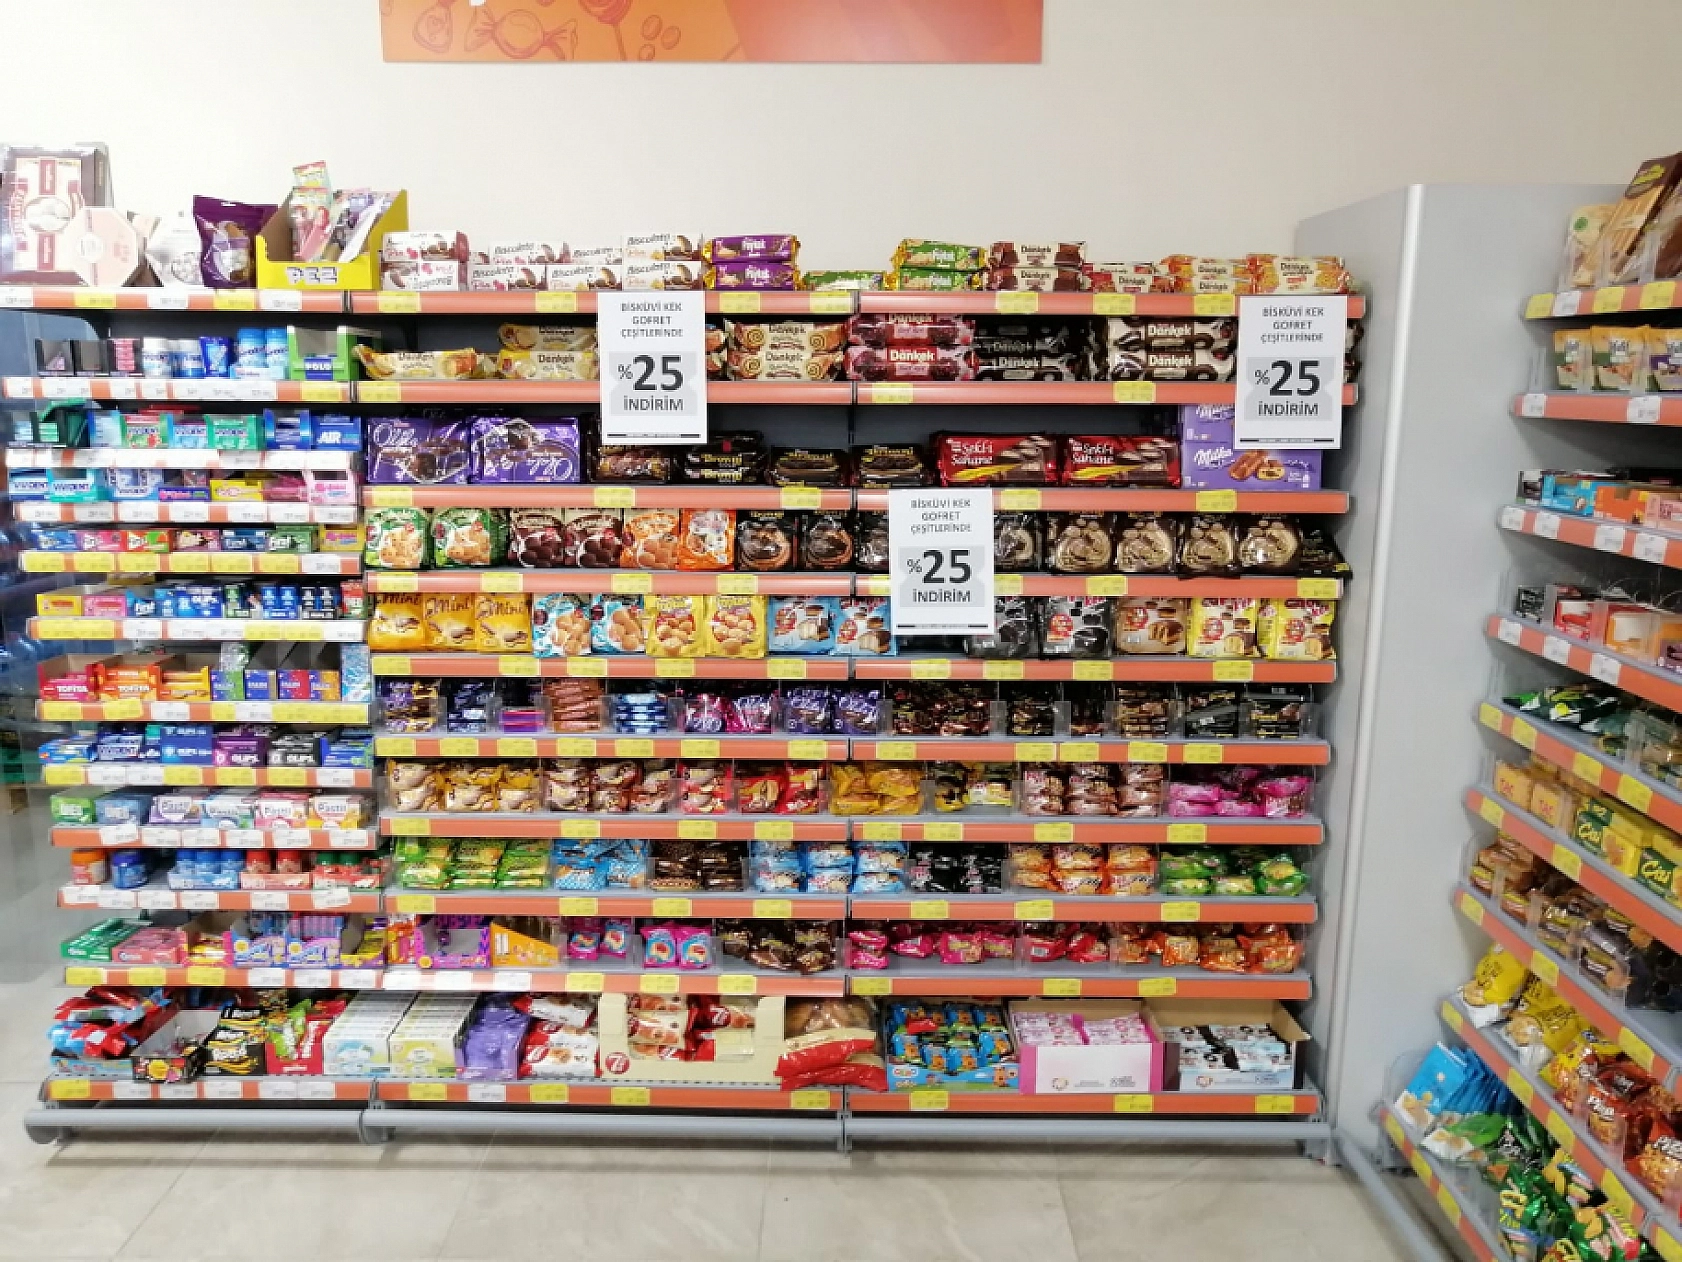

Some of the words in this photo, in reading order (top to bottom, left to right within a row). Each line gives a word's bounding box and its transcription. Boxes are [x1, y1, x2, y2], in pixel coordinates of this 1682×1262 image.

[621, 301, 661, 311] BİSKÜVİ
[663, 302, 684, 311] KEK
[1261, 305, 1304, 317] BİSKÜVİ
[1305, 306, 1325, 317] KEK
[632, 315, 672, 325] GOFRET
[1272, 320, 1314, 330] GOFRET
[620, 328, 684, 339] ÇEŞİTLERİNDE
[1260, 332, 1324, 344] ÇEŞİTLERİNDE
[623, 395, 684, 411] İNDİRİM
[1257, 400, 1319, 416] İNDİRİM
[910, 497, 950, 509] BİSKÜVİ
[952, 498, 972, 508] KEK
[921, 511, 961, 521] GOFRET
[910, 523, 972, 535] ÇEŞİTLERİNDE
[912, 588, 972, 602] İNDİRİM
